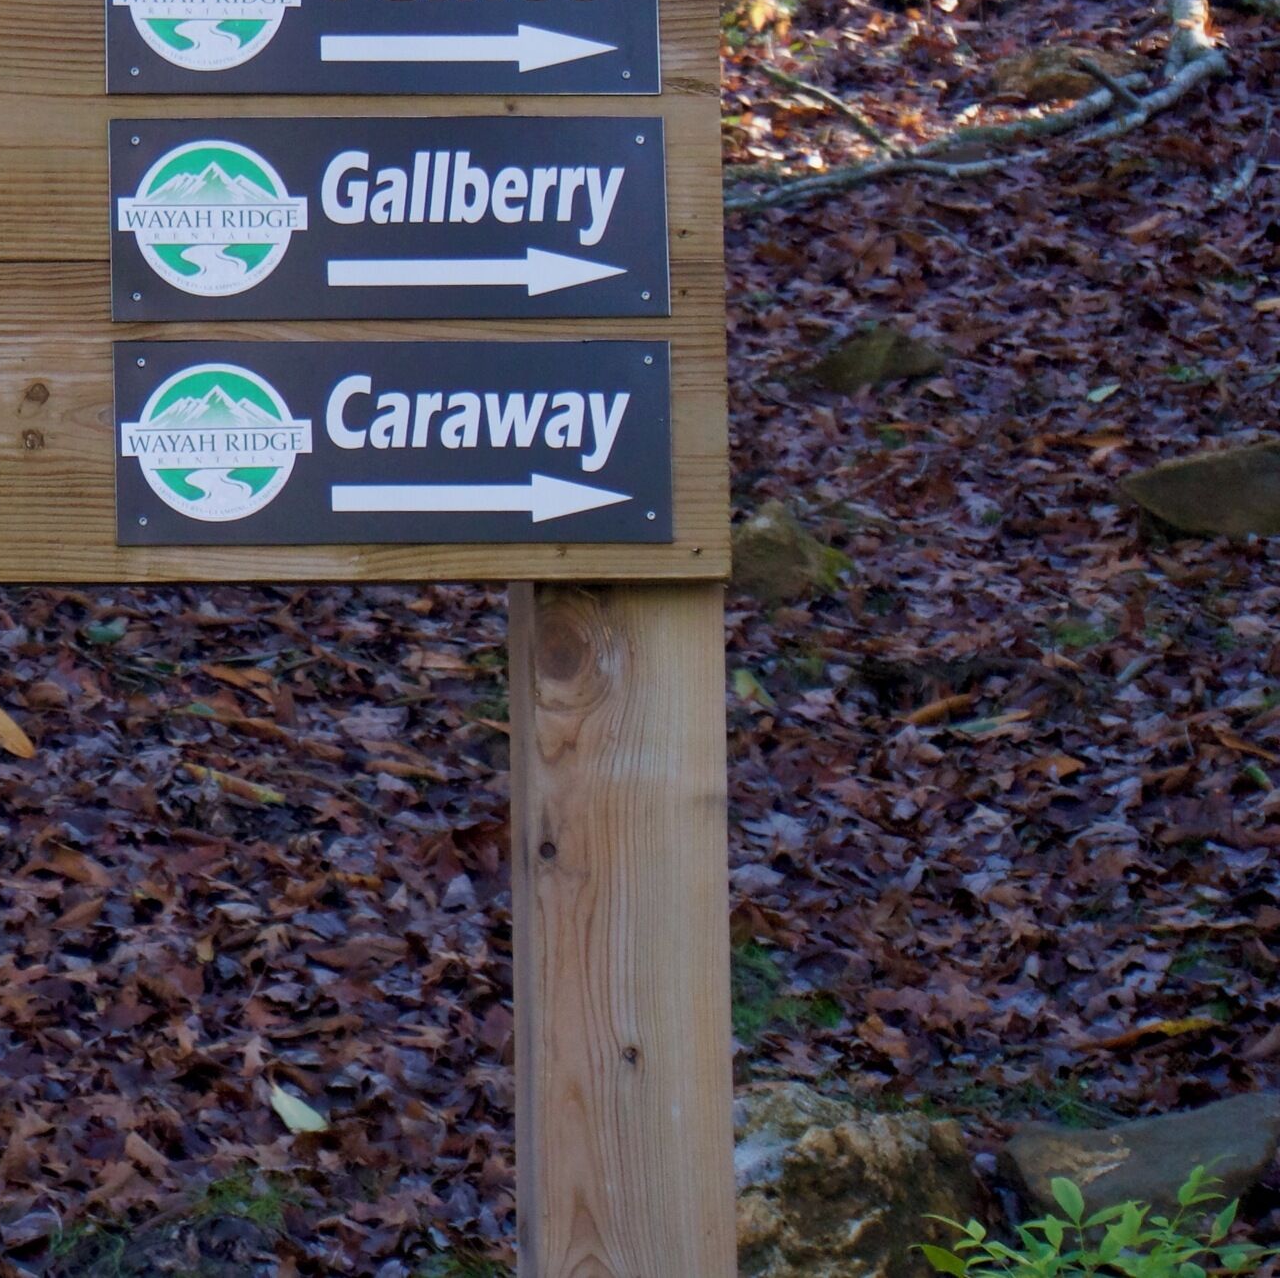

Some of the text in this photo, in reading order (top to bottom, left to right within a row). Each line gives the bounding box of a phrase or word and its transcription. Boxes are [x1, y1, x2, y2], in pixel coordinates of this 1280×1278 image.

[125, 210, 298, 228] WAYAH RIDGE
[321, 151, 626, 246] Gallberry
[129, 432, 303, 453] WAYAH RIDGE
[325, 375, 630, 472] Caraway
